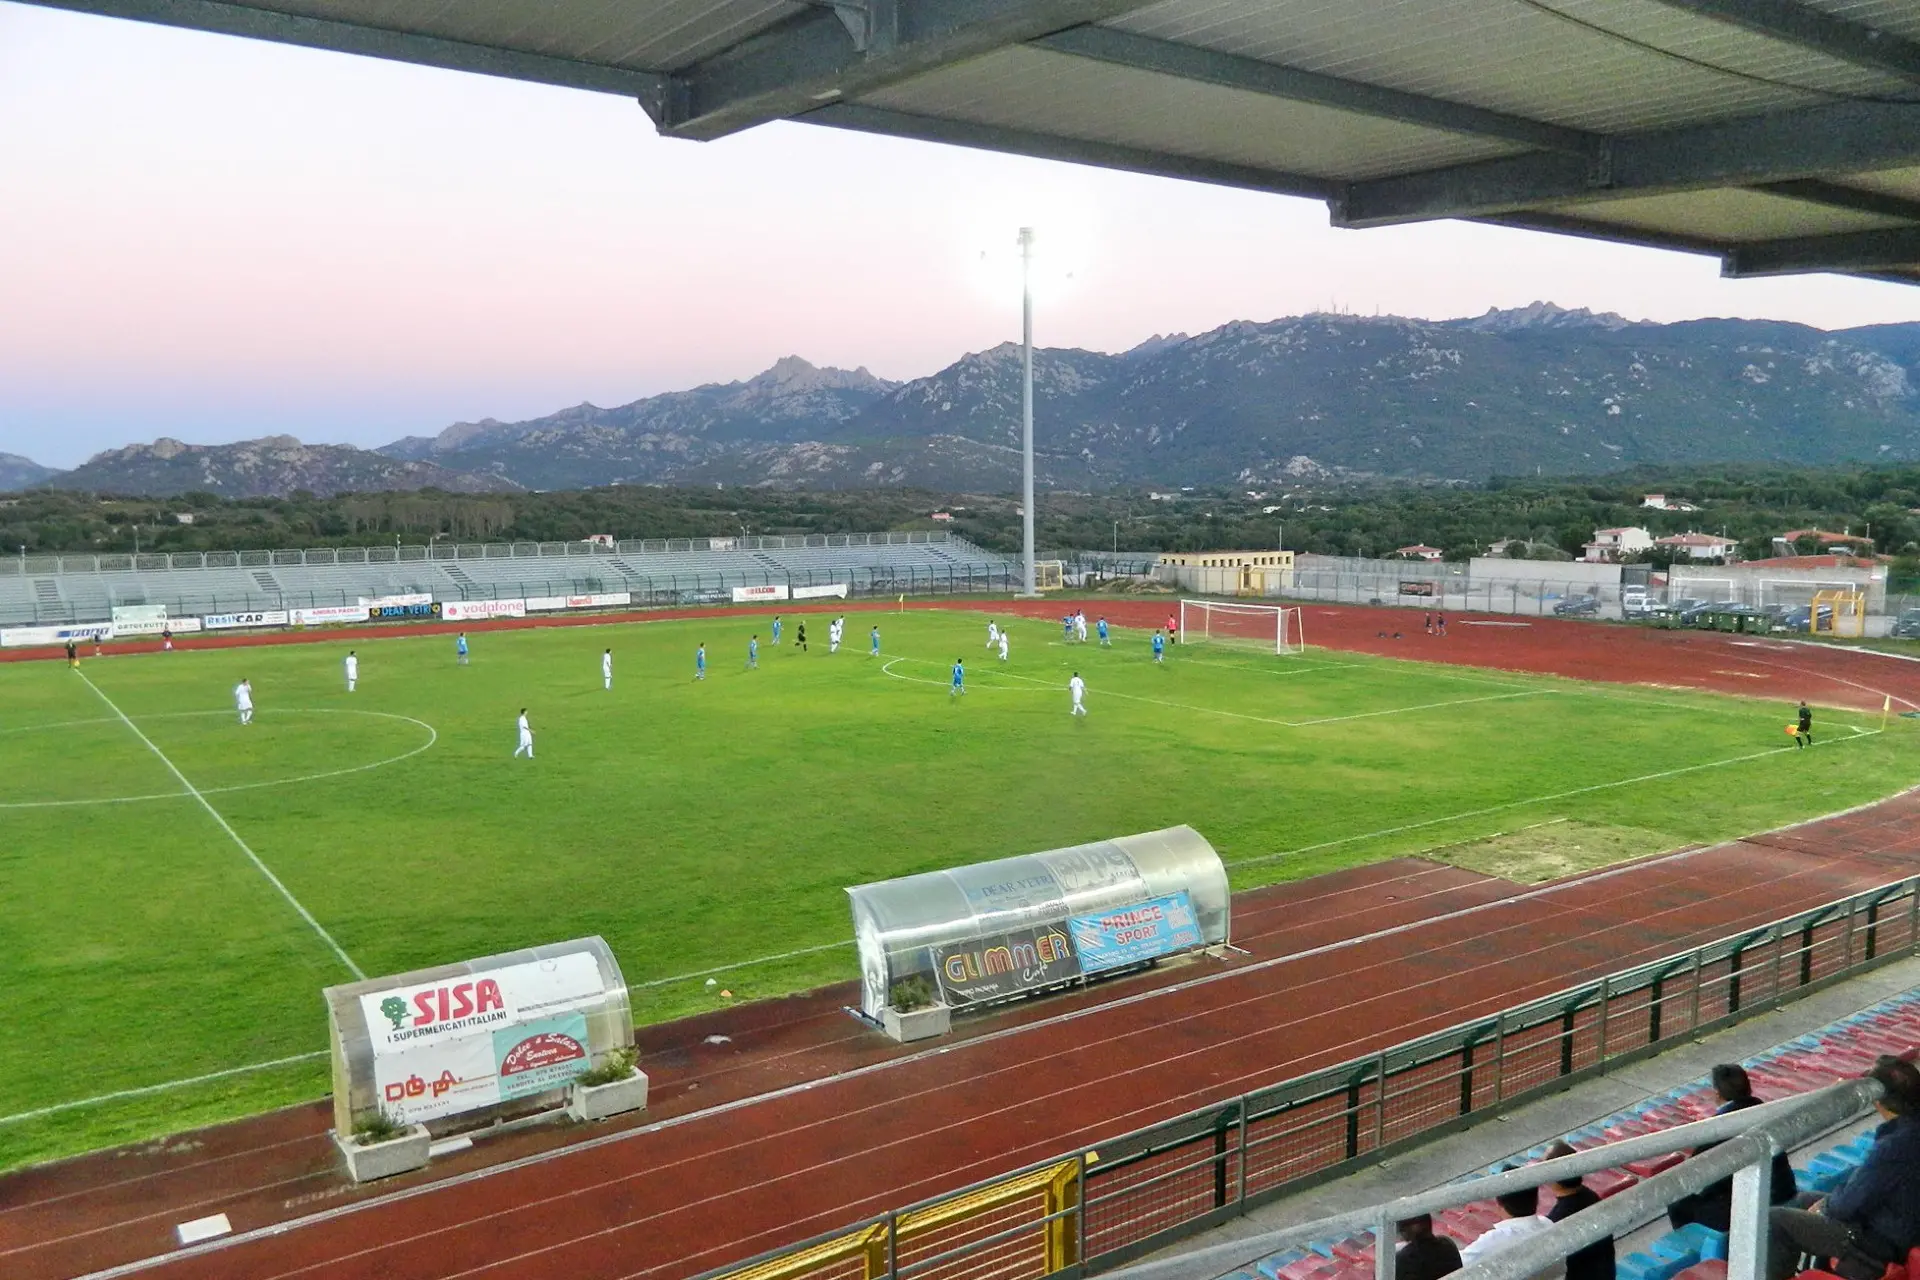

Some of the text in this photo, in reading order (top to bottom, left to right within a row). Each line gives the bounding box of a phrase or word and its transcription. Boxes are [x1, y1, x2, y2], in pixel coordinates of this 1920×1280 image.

[382, 606, 404, 616] DEAR
[463, 602, 523, 613] vodafone
[1100, 905, 1163, 932] PRINCE
[1115, 924, 1158, 945] SPORT
[945, 933, 1070, 982] GLIMMER
[413, 978, 504, 1027] SISA
[394, 1021, 466, 1042] SUPERMERCATI
[468, 1011, 507, 1026] ITALIANI
[506, 1042, 532, 1065] Dolce
